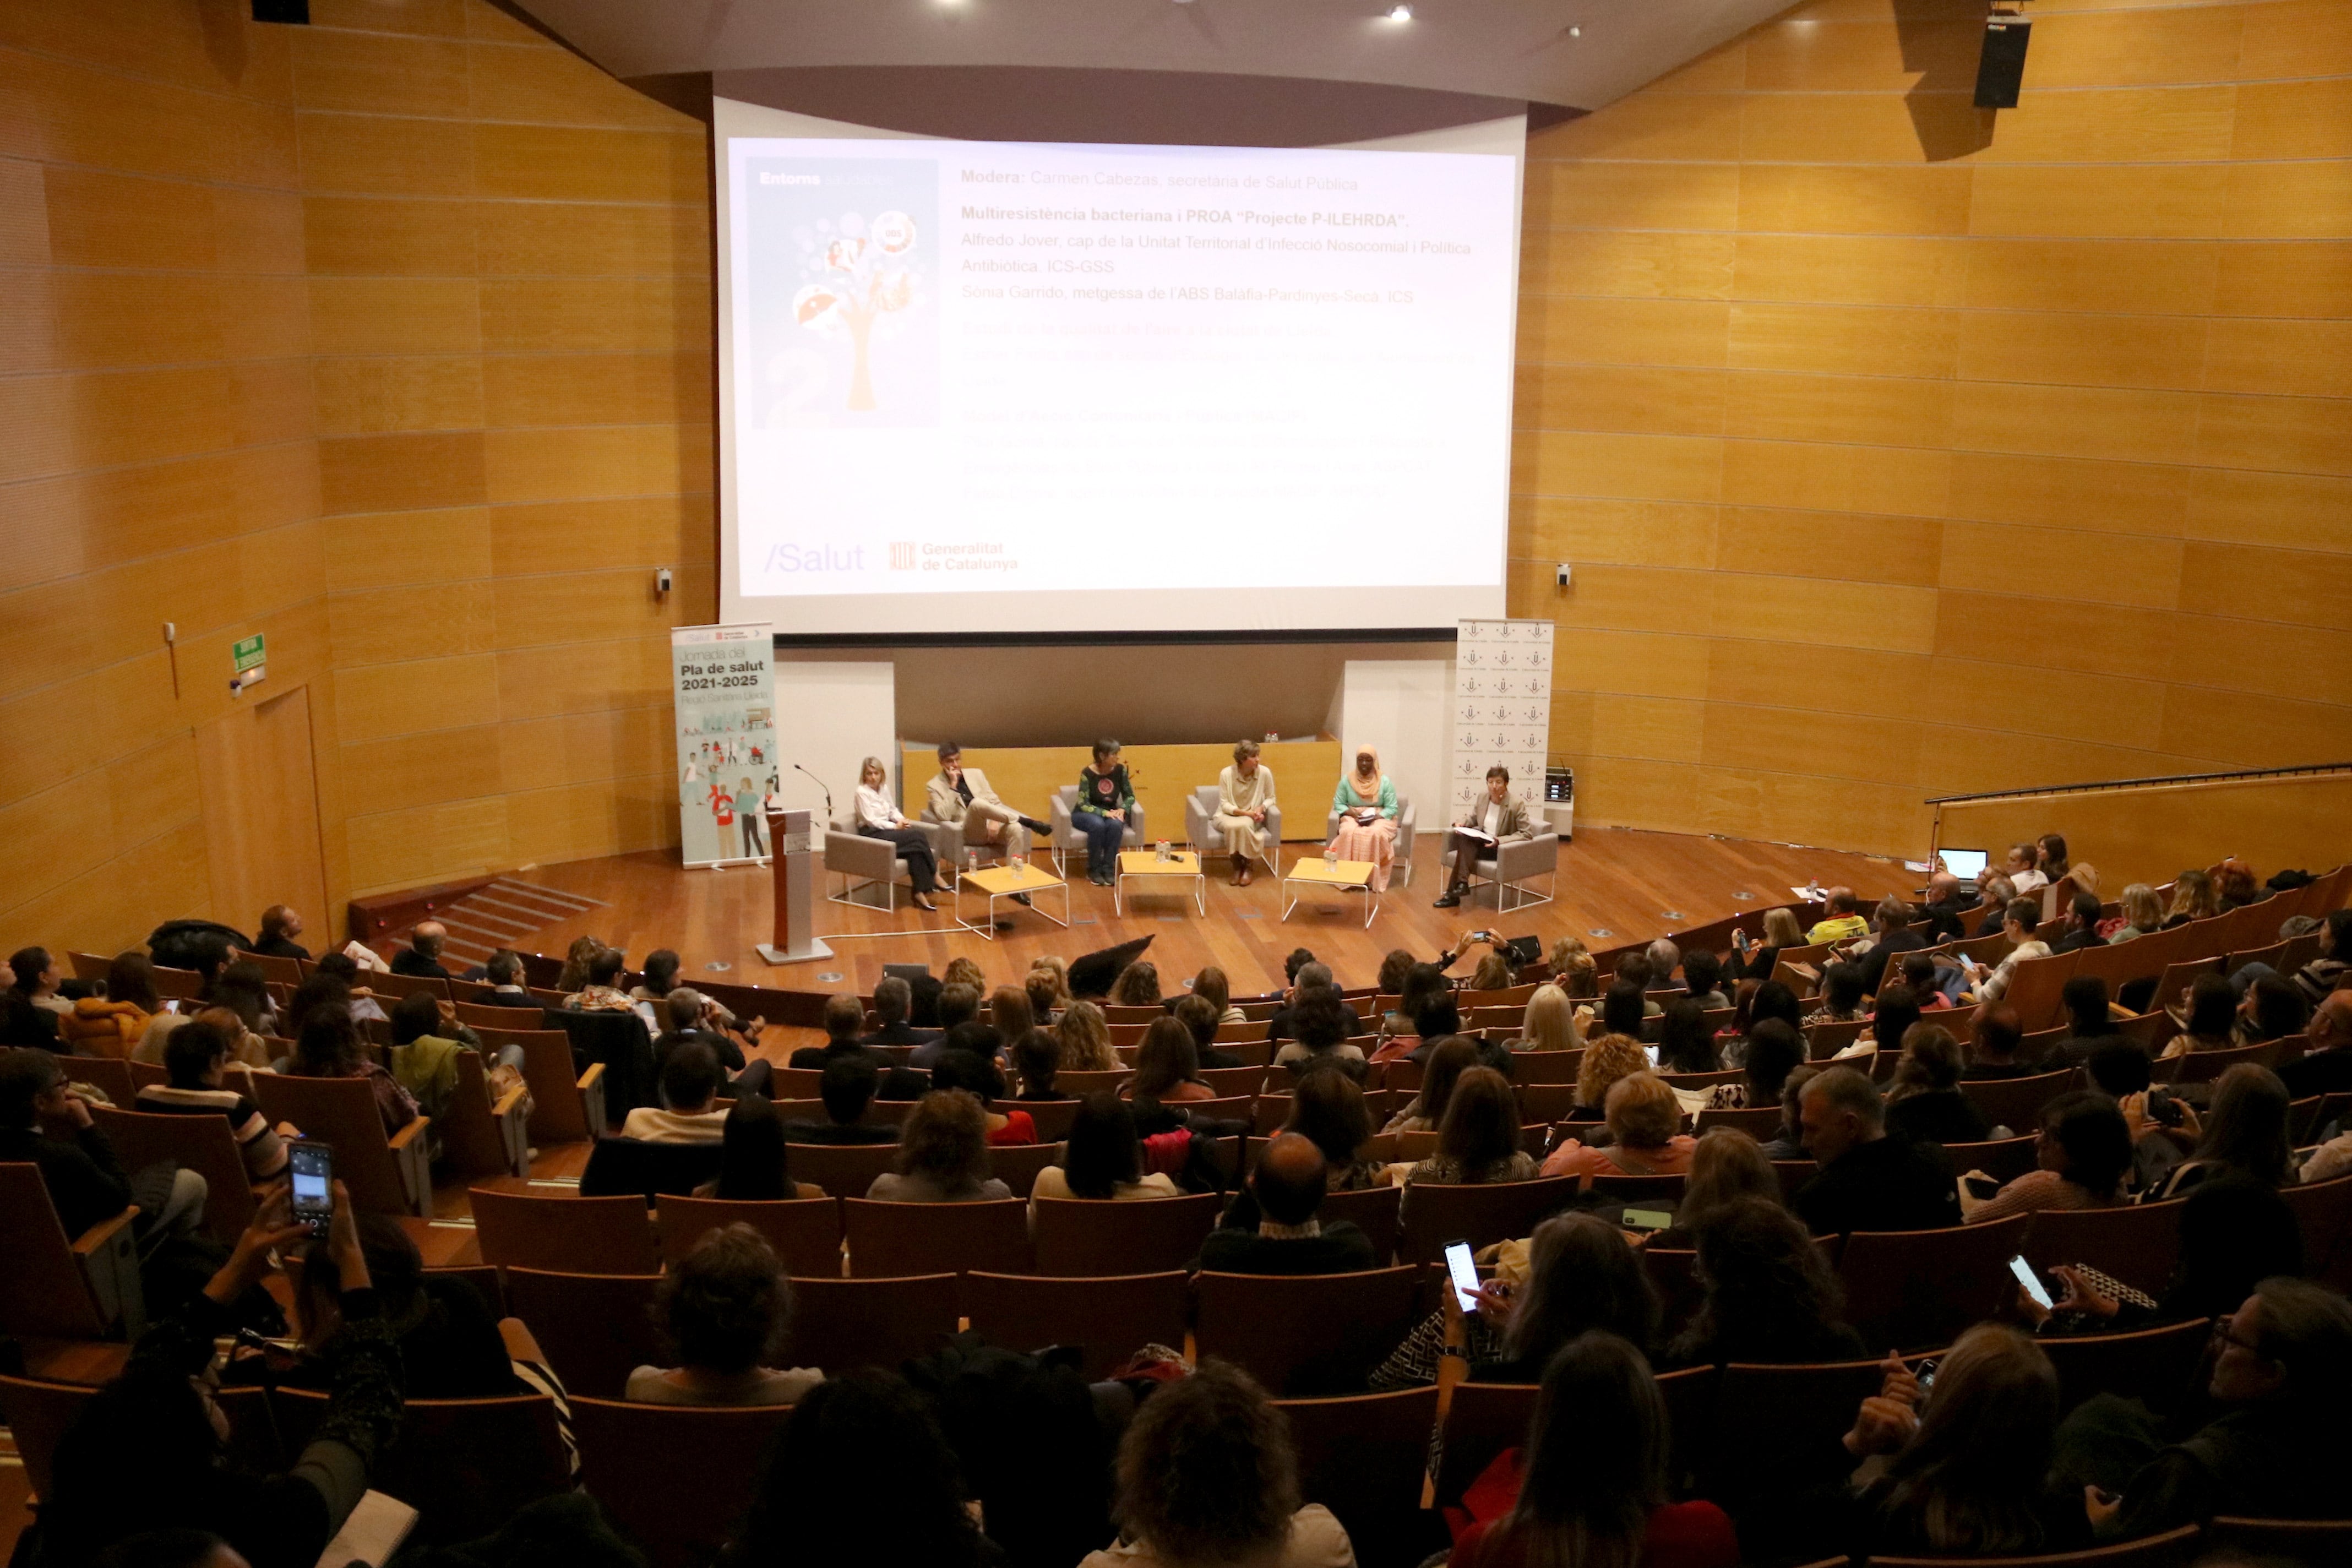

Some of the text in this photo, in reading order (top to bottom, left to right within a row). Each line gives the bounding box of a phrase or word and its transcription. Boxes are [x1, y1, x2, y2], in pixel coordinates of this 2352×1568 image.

[760, 172, 820, 184] Entorns
[961, 169, 1025, 184] Modera:
[1030, 171, 1089, 184] Carmen
[1094, 172, 1162, 187] Cabezas,
[1243, 176, 1261, 188] de
[1265, 176, 1302, 189] Salut
[1306, 176, 1358, 190] Pública
[961, 206, 1086, 221] Multiresistència
[1091, 208, 1173, 222] bacteriana
[1177, 209, 1182, 222] i
[1186, 209, 1233, 223] PROA
[961, 232, 1015, 247] Alfredo
[1018, 233, 1062, 249] Jover,
[1066, 237, 1095, 251] cap
[1097, 235, 1117, 248] de
[1120, 235, 1134, 248] la
[1138, 235, 1182, 249] Unitat
[1185, 235, 1251, 250] Territorial
[1326, 238, 1409, 253] Nosocomial
[1412, 241, 1417, 253] i
[1419, 241, 1472, 256] Política
[1047, 259, 1115, 274] ICS-GSS
[1009, 285, 1068, 301] Garrido,
[1072, 287, 1144, 303] metgessa
[1146, 286, 1166, 300] de
[1388, 290, 1414, 304] ICS
[922, 542, 1004, 556] Generalitat
[764, 543, 865, 573] /Salut
[922, 557, 1019, 572] de Catalunya
[679, 647, 745, 662] Jornada del
[680, 661, 764, 676] Pla de salut
[682, 675, 758, 690] 2021-2025
